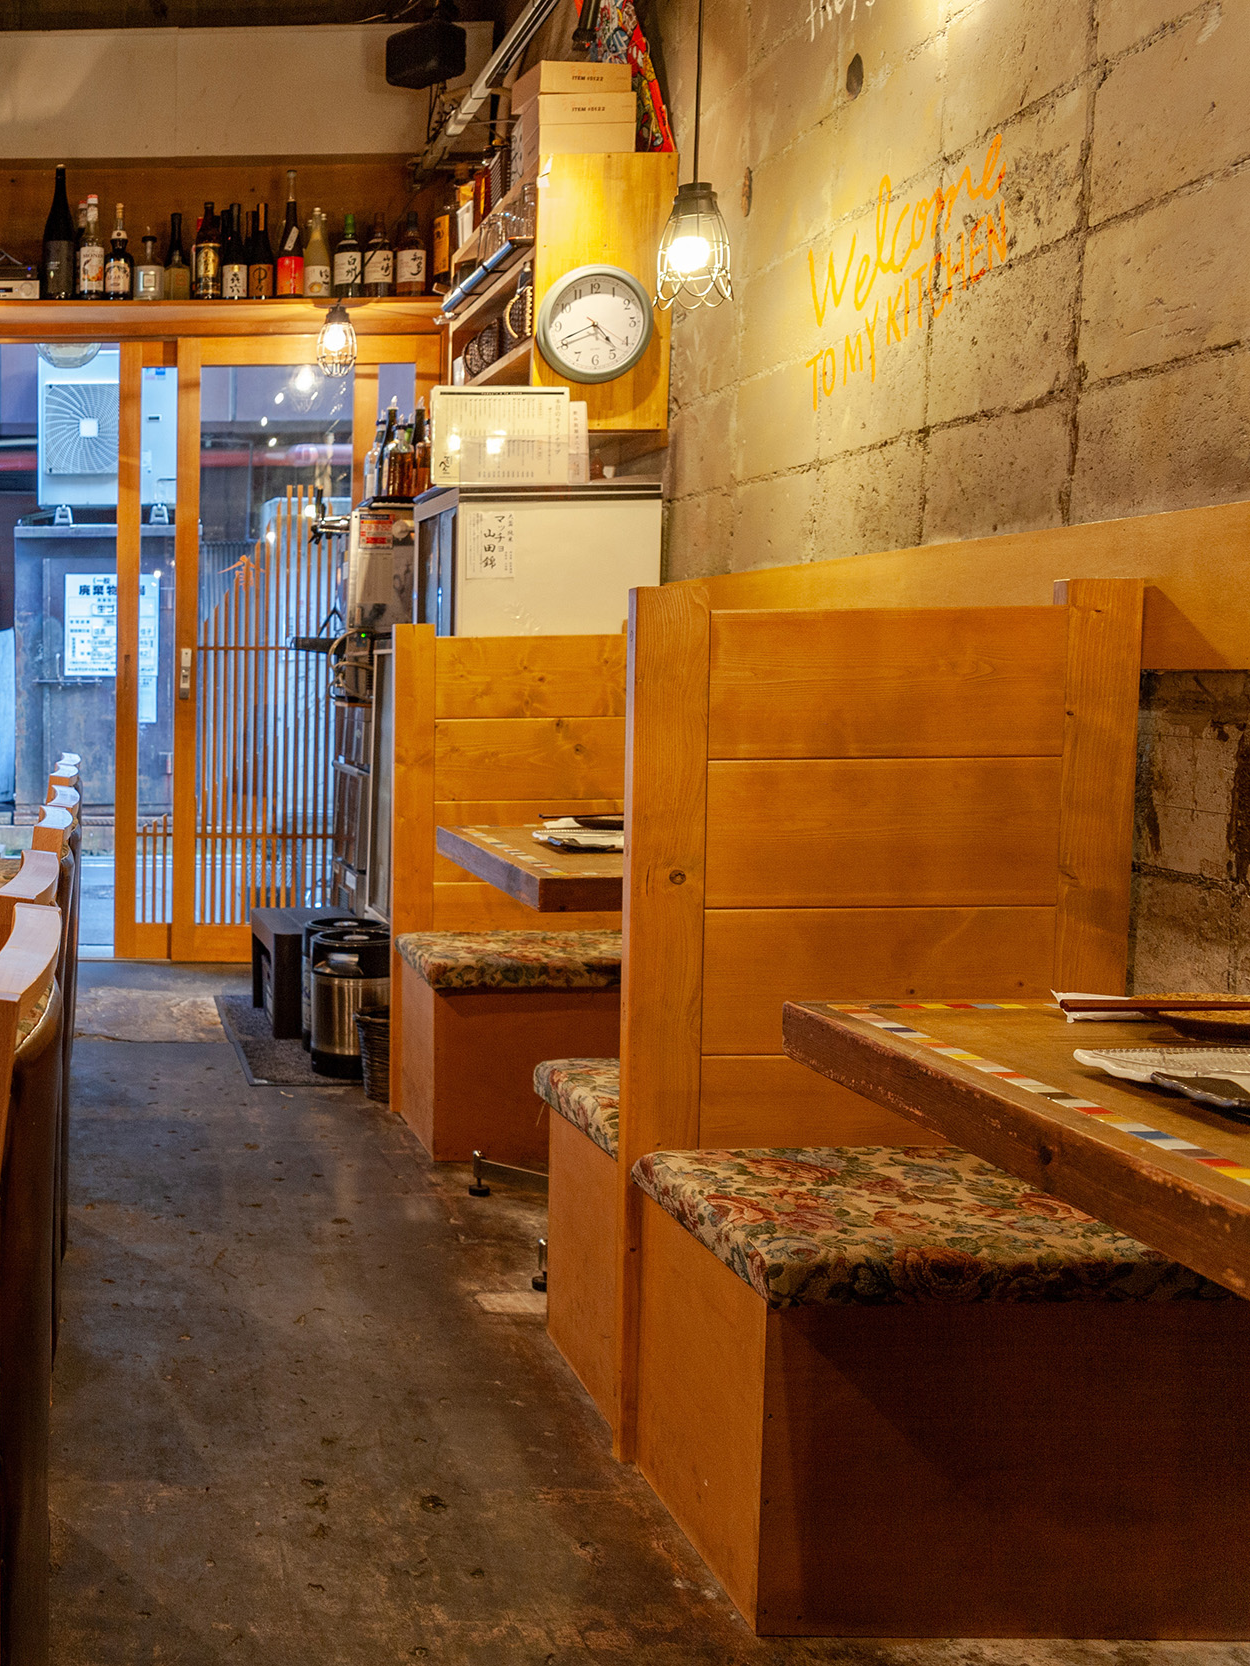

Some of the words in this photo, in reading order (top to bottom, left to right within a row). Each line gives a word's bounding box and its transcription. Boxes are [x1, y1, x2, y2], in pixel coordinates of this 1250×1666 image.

[808, 133, 1006, 328] Welcome
[590, 282, 601, 294] 12
[612, 287, 616, 298] 1
[574, 289, 582, 300] 11
[561, 303, 572, 313] 10
[623, 299, 631, 310] 2
[806, 347, 836, 412] TO
[843, 300, 879, 387] MY
[886, 199, 1007, 346] KITCHEN
[554, 321, 562, 332] 9
[629, 316, 637, 328] 3
[622, 336, 629, 346] 4
[574, 351, 582, 362] 7
[591, 354, 600, 366] 6
[609, 349, 616, 360] 5
[494, 515, 506, 553] マッチョ
[481, 528, 497, 569] 山田錦
